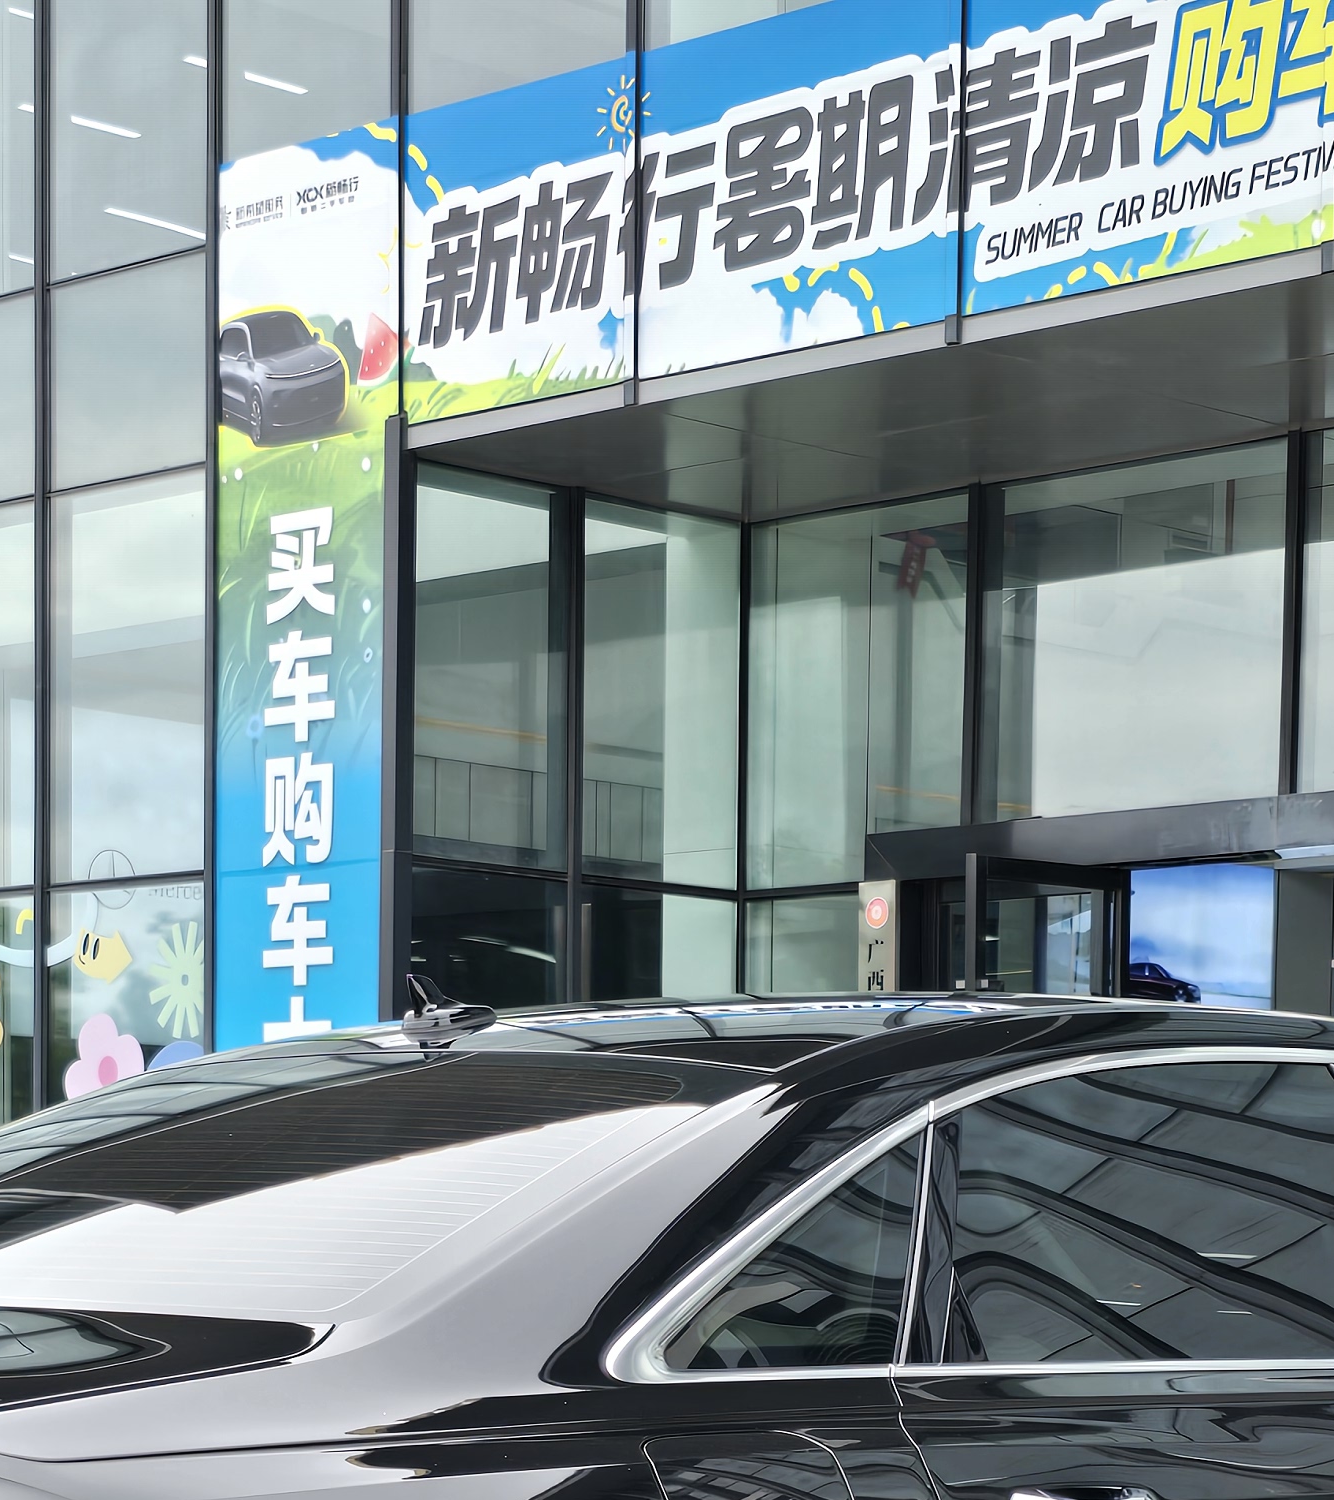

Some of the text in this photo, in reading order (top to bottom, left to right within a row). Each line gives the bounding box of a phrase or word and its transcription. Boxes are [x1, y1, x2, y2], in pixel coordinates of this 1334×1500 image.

[985, 212, 1083, 265] SUMMER
[1097, 199, 1144, 234] CAR
[1152, 168, 1243, 220] BUYING
